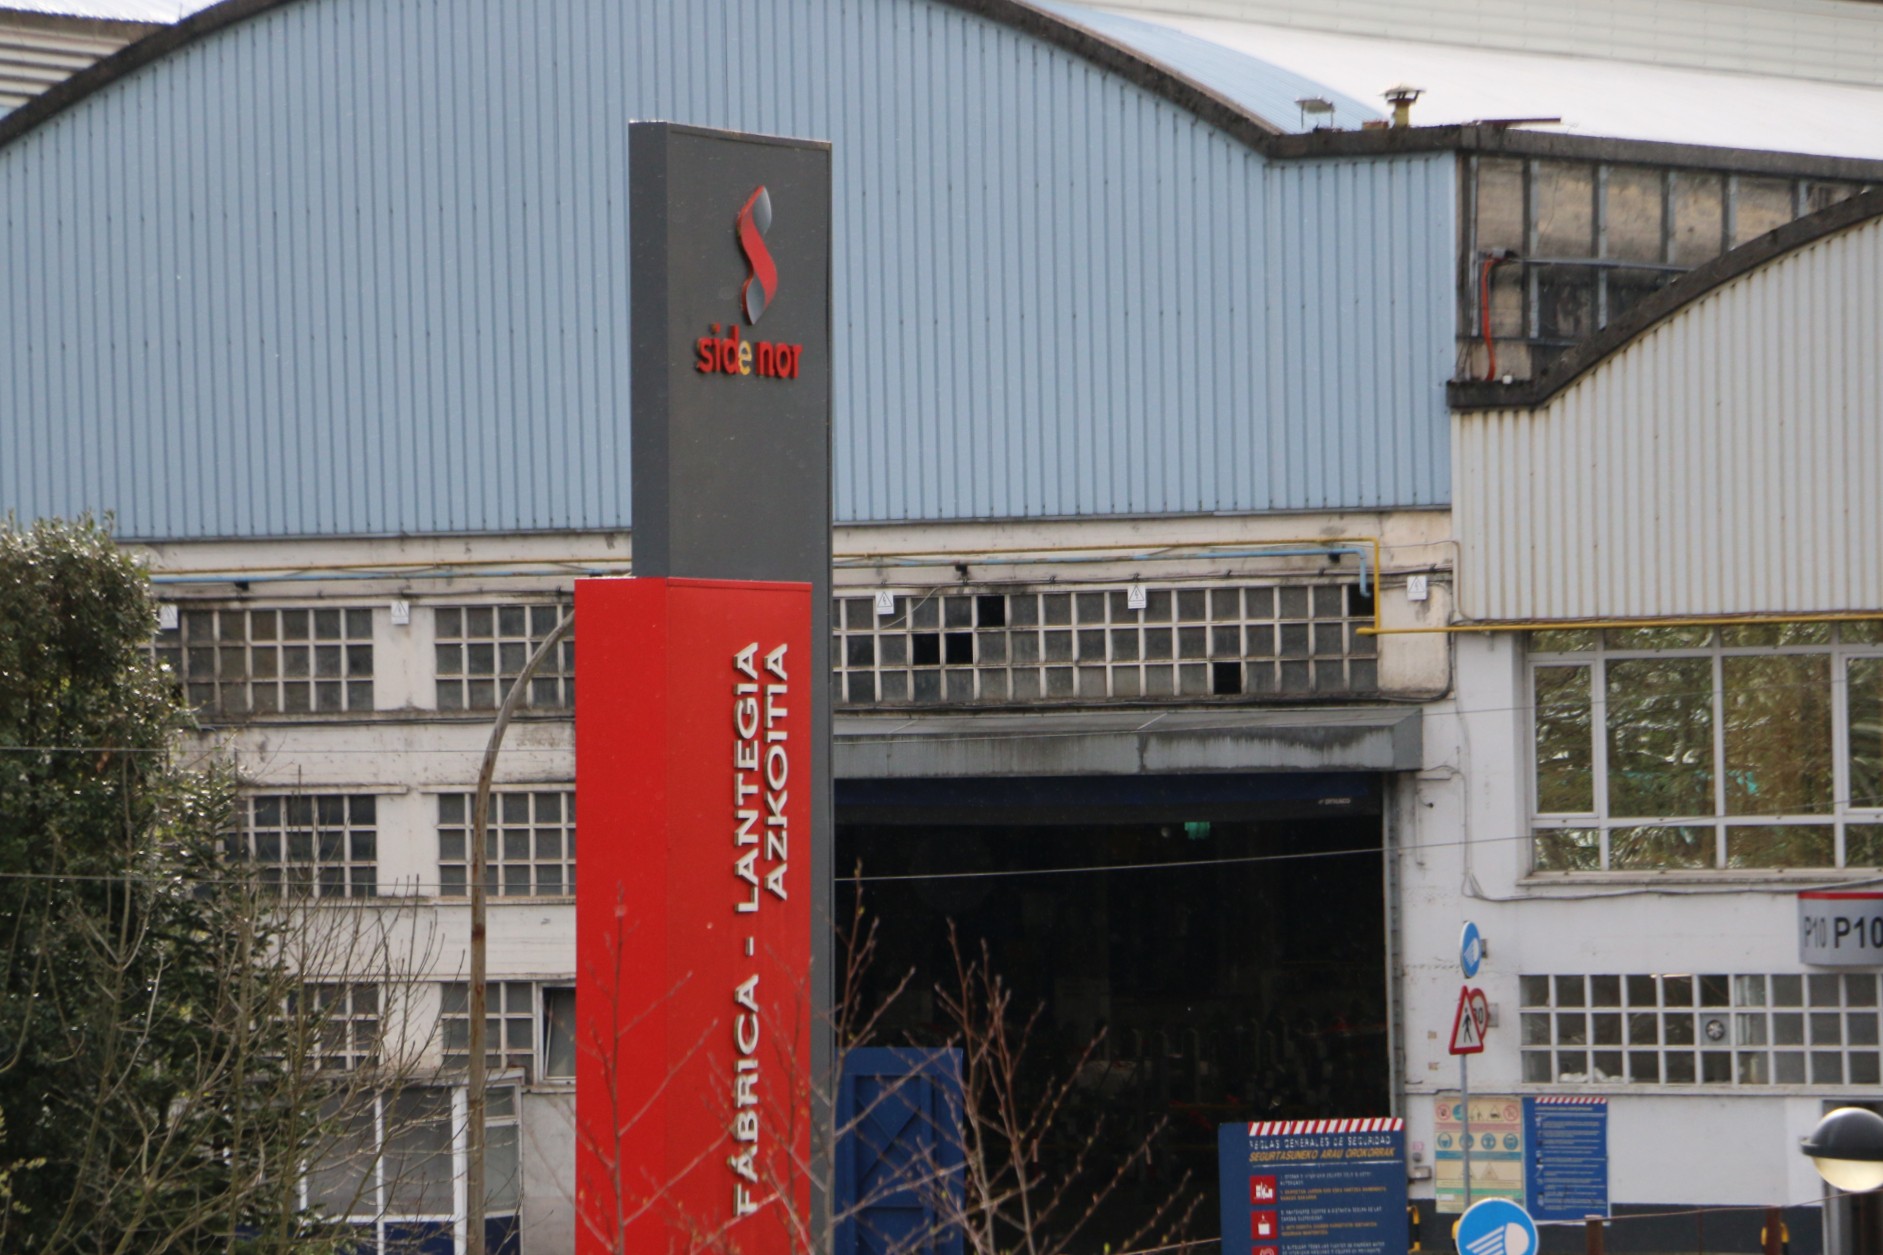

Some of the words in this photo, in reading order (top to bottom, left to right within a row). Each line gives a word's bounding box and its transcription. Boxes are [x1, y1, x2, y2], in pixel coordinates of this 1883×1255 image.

[733, 642, 759, 912] LANTEGIA
[763, 643, 788, 900] AZKOITIA
[1834, 916, 1883, 949] P10
[727, 973, 759, 1217] FÁBRICA
[1284, 1136, 1330, 1149] GENERALES
[1333, 1136, 1343, 1146] DE
[1348, 1135, 1391, 1147] SEGURIDAD
